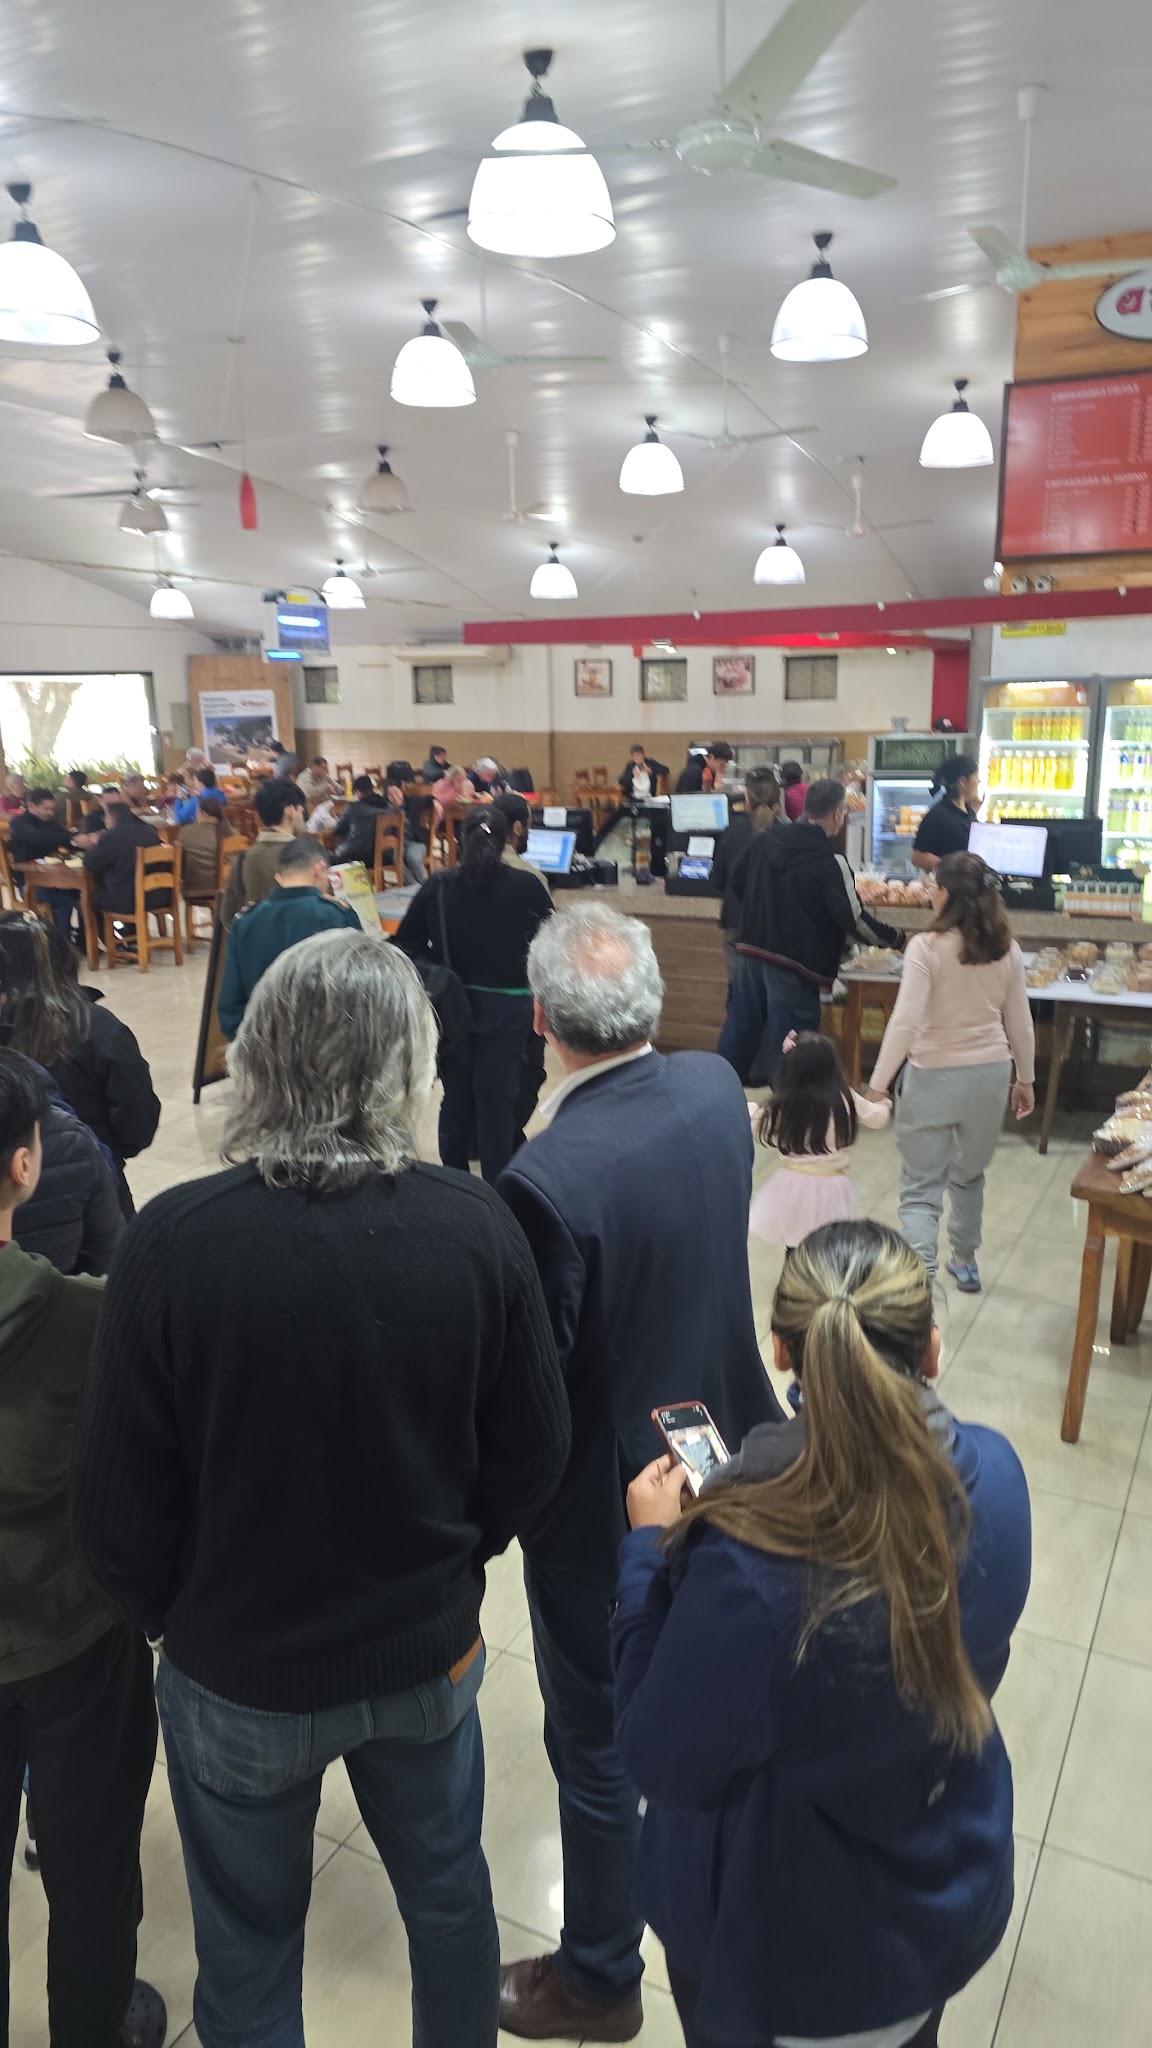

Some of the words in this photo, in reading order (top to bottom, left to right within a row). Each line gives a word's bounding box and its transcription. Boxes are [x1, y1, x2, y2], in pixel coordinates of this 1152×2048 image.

[1051, 387, 1106, 402] EMPANADAS
[1045, 476, 1101, 489] EMPANADAS
[1114, 471, 1149, 483] HORNO
